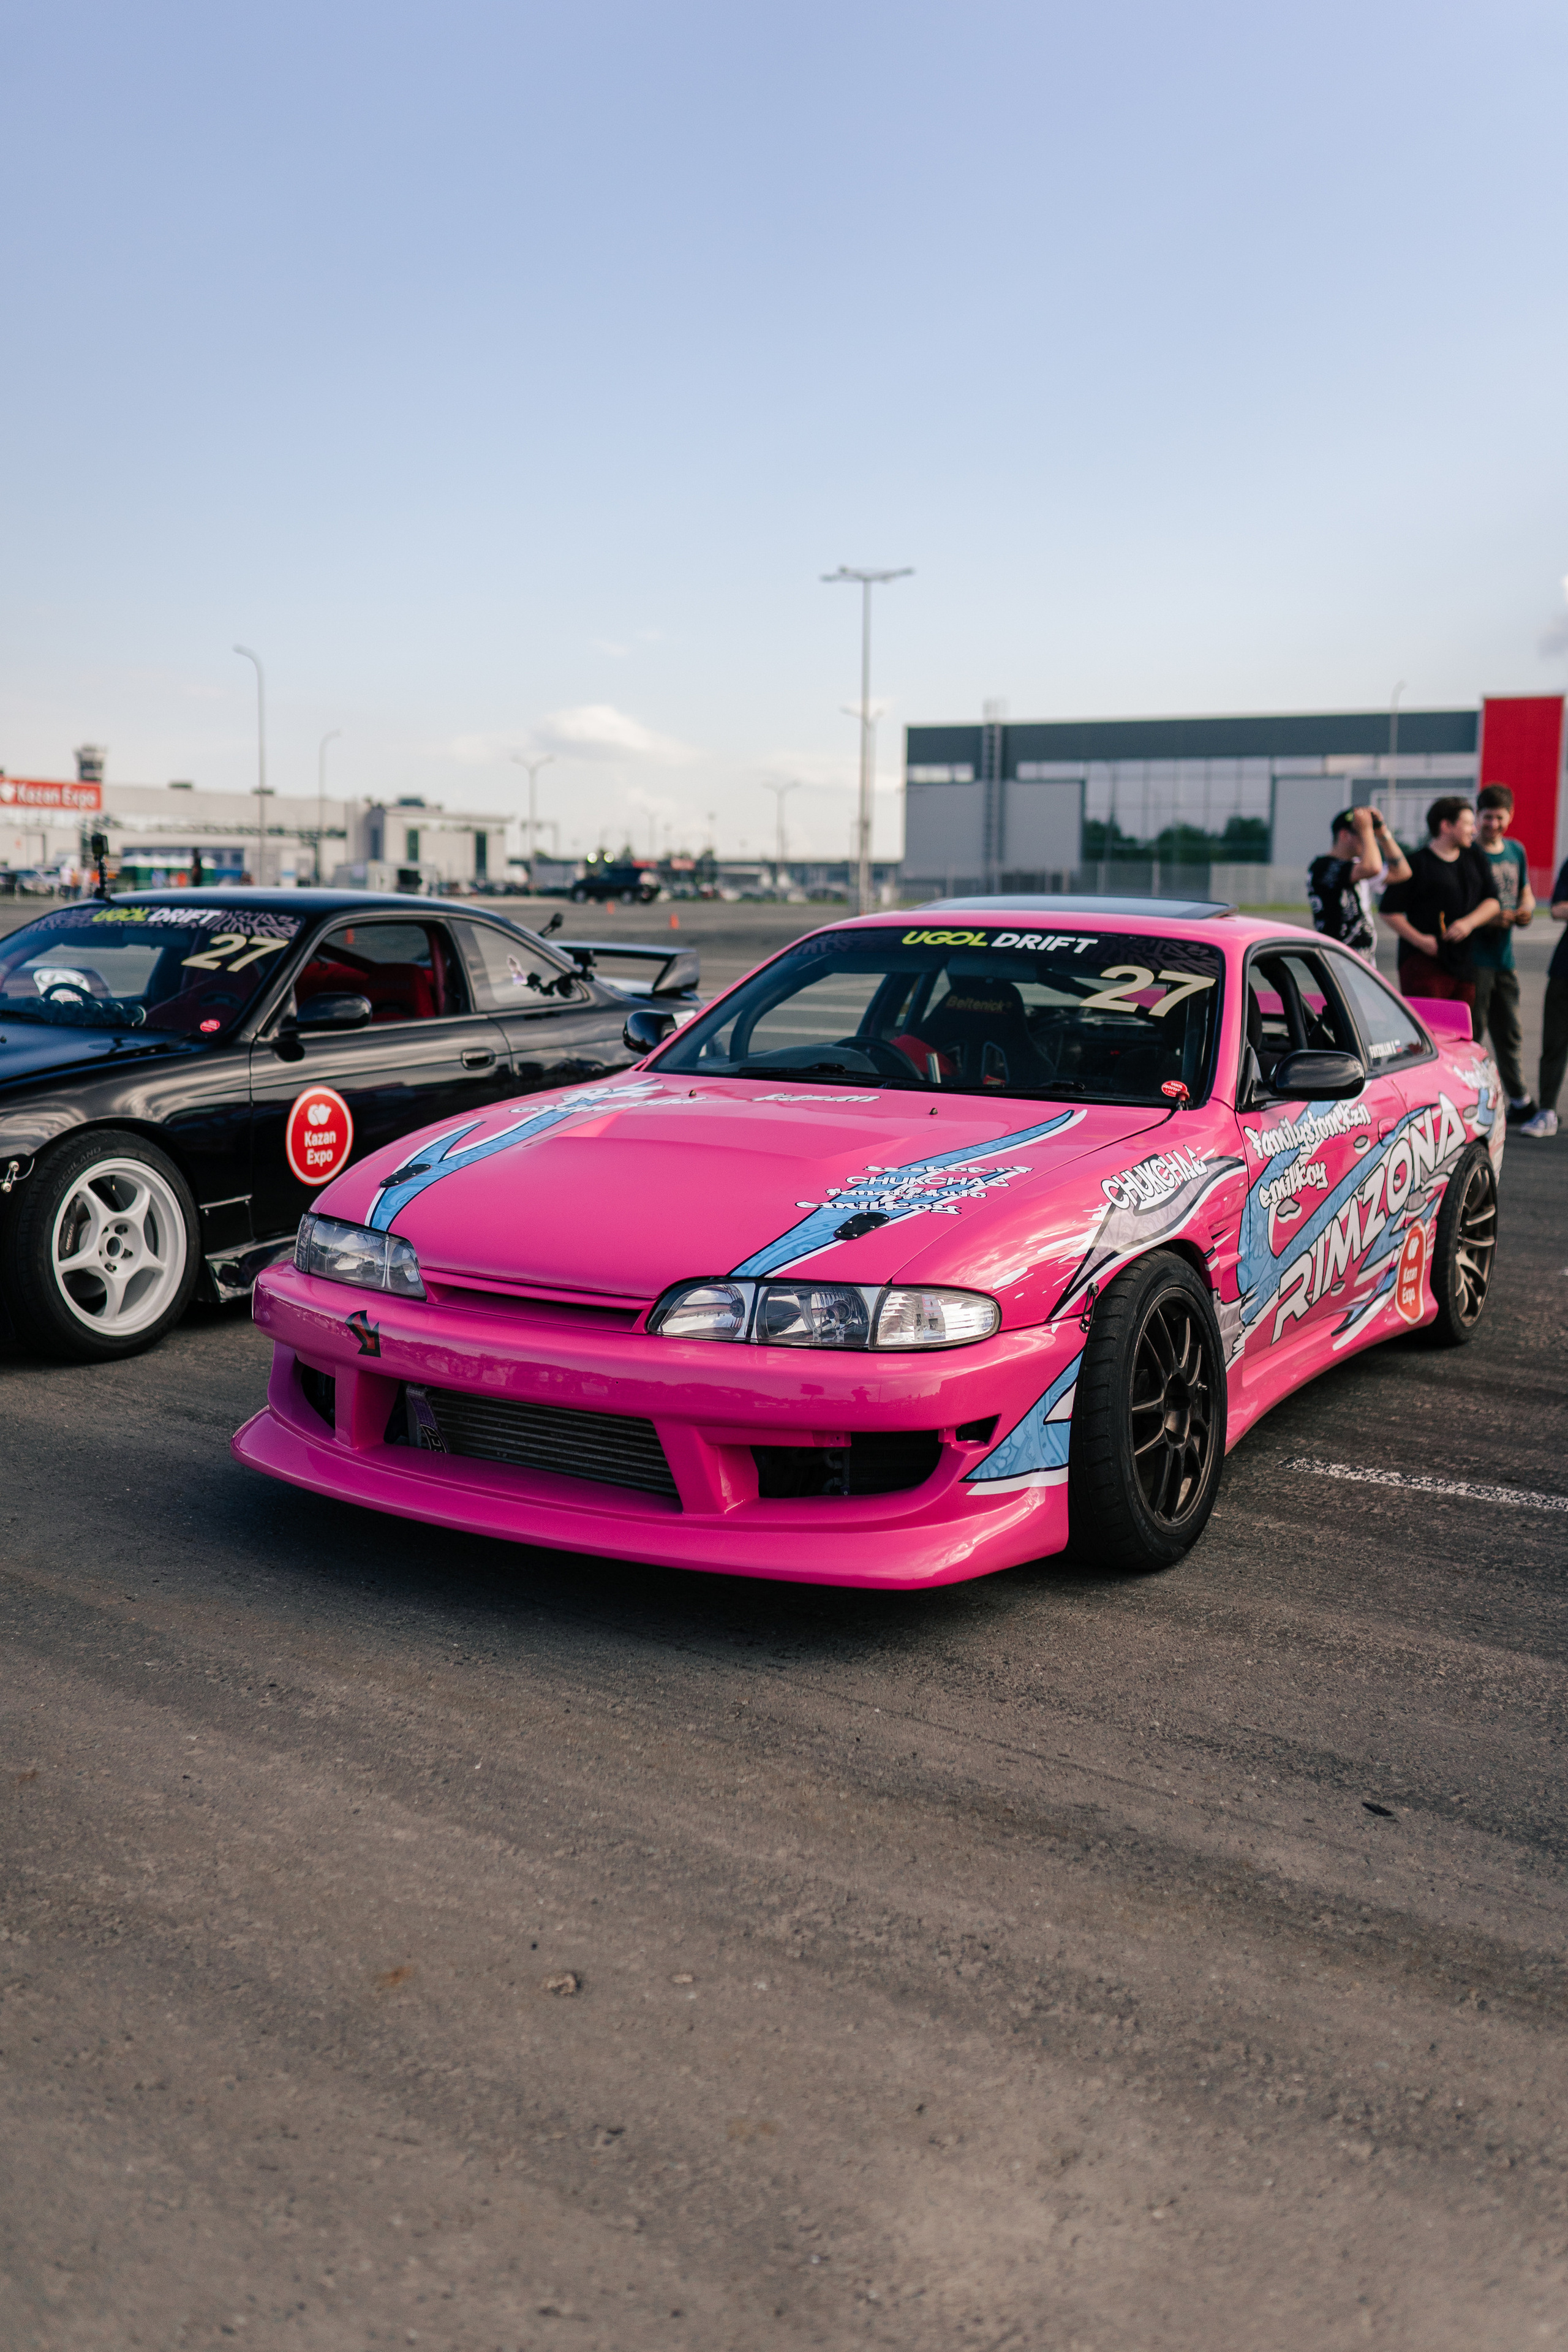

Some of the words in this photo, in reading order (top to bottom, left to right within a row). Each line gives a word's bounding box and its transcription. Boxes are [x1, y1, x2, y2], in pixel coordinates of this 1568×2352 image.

[17, 783, 60, 805] Kazan
[61, 785, 96, 811] Expo
[148, 908, 222, 924] DRIFT
[181, 932, 290, 973] 27
[902, 931, 989, 947] UGOL
[990, 932, 1099, 954] DRIFT
[1079, 965, 1216, 1017] 27
[304, 1130, 337, 1148] Kazan
[306, 1148, 334, 1167] Expo
[1271, 1093, 1466, 1346] RIMZONA
[1403, 1265, 1419, 1285] Kazan
[1401, 1286, 1417, 1306] Expo
